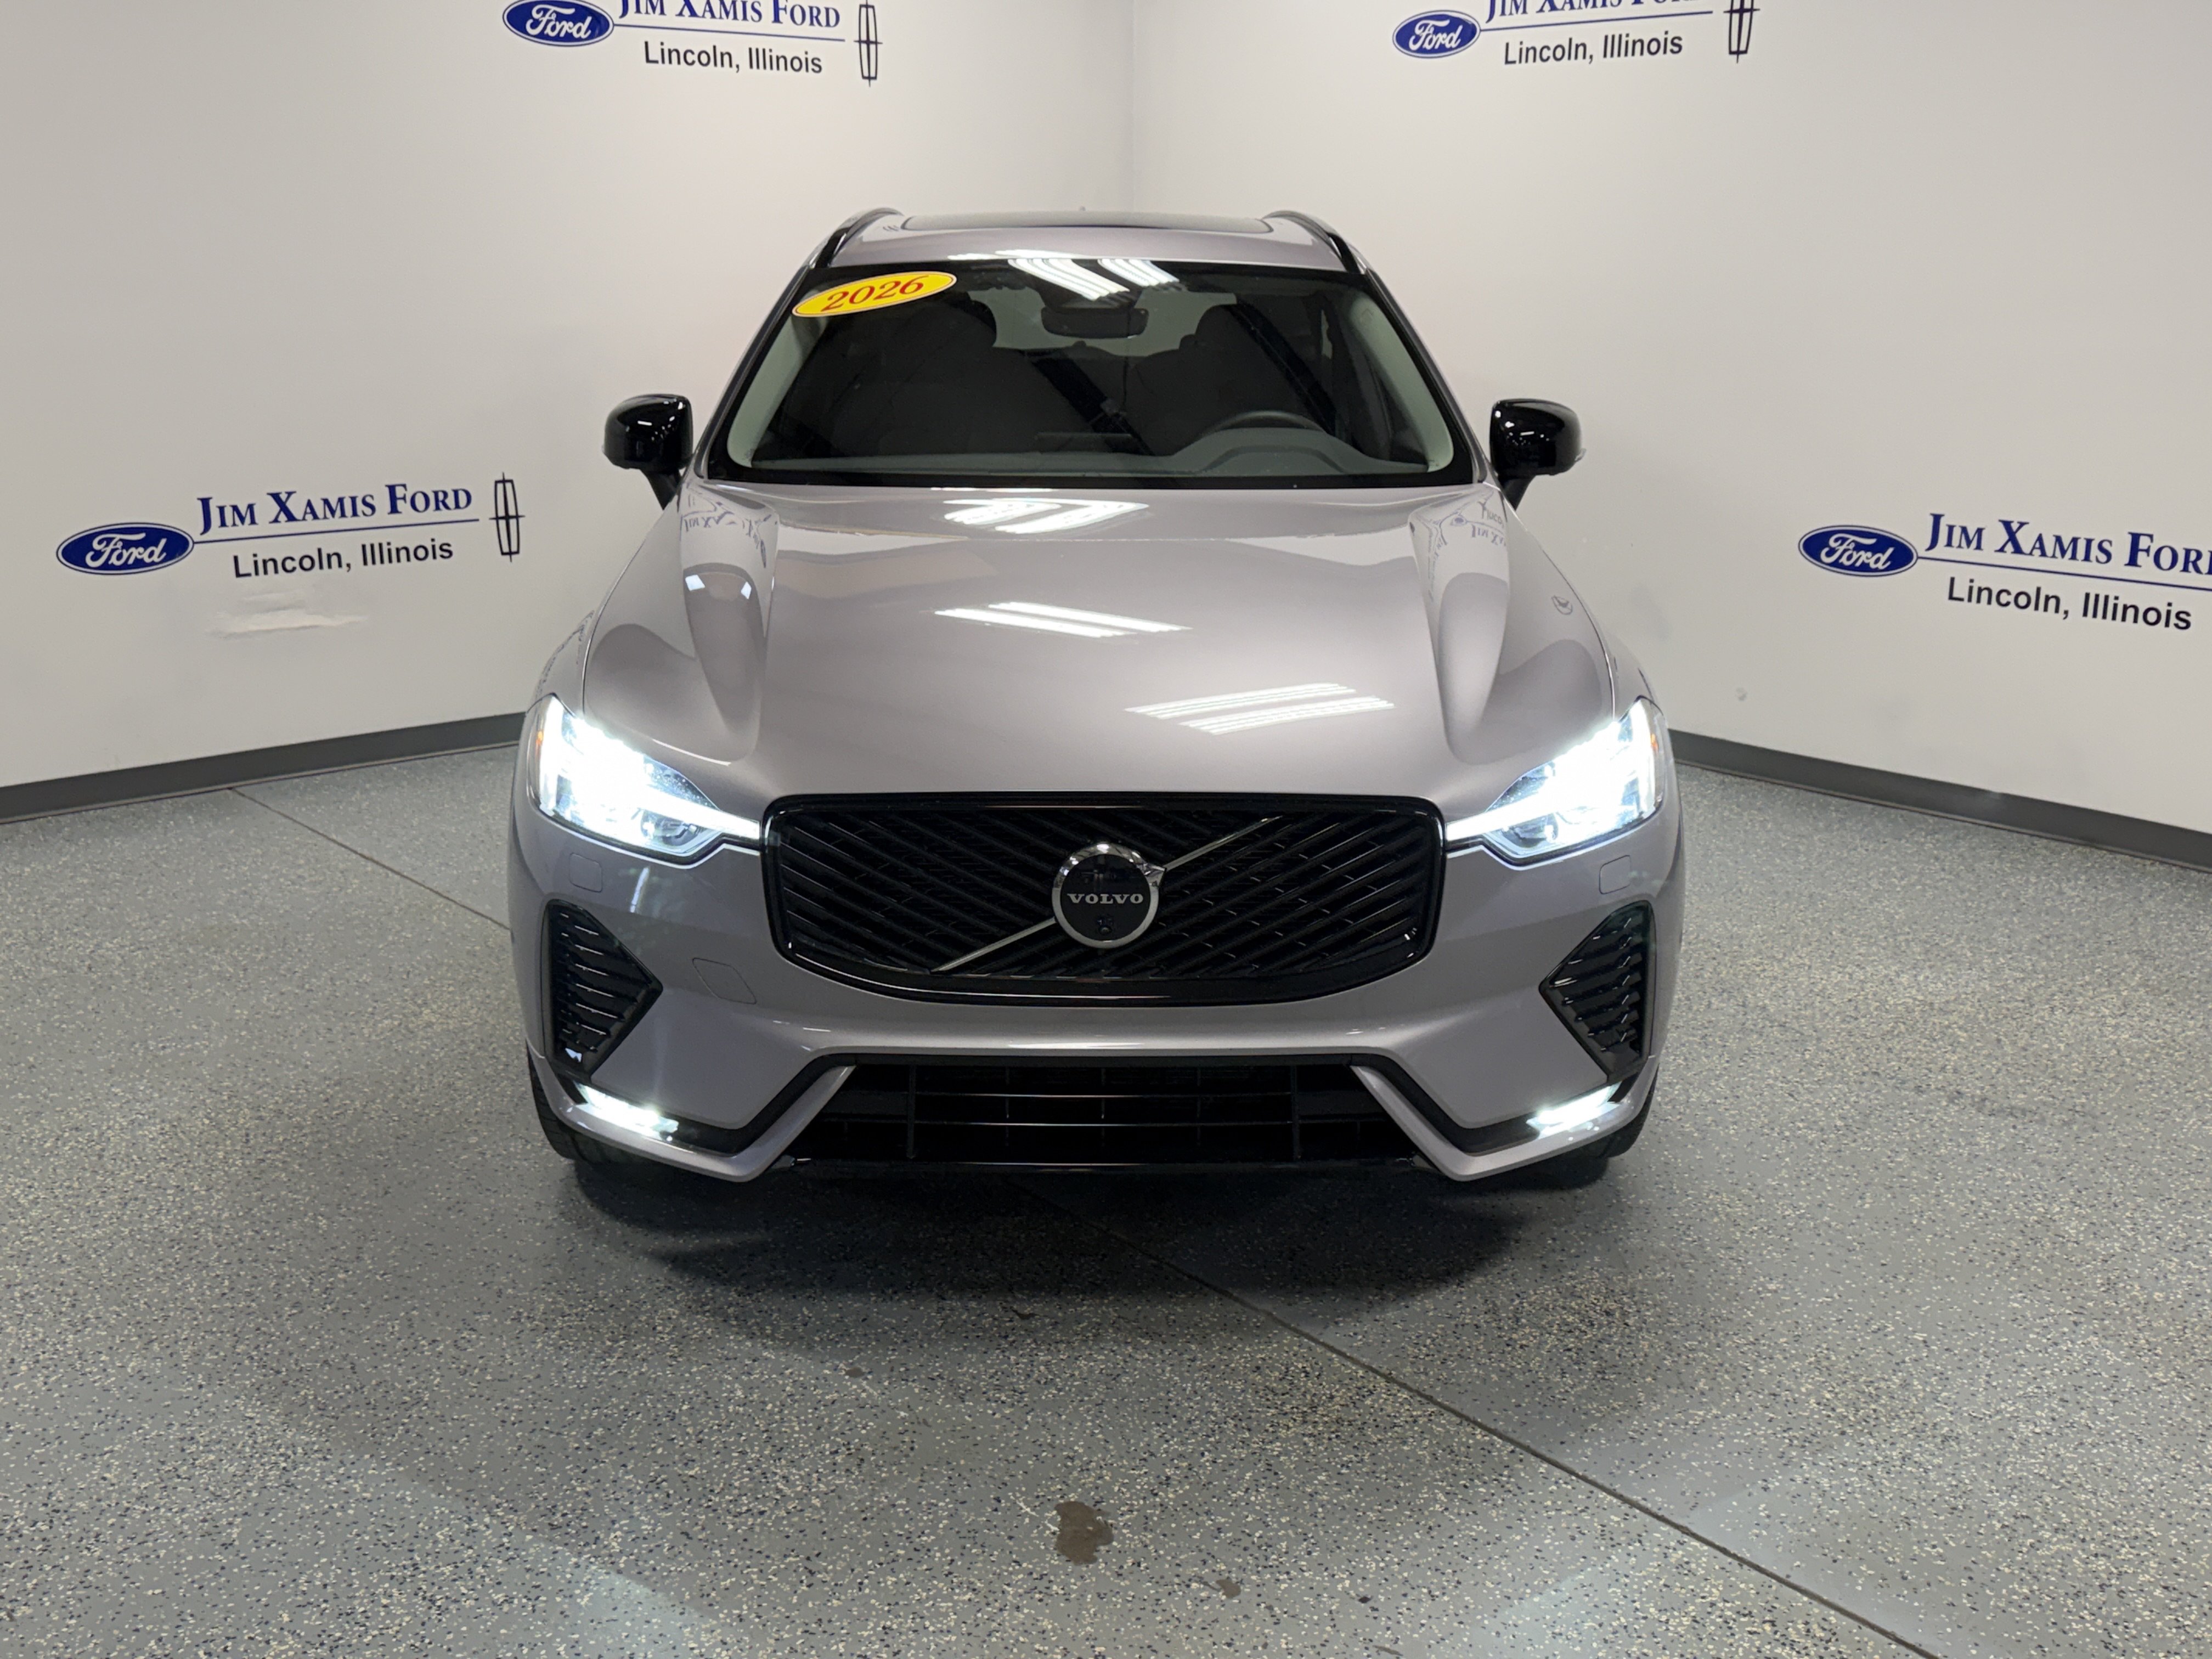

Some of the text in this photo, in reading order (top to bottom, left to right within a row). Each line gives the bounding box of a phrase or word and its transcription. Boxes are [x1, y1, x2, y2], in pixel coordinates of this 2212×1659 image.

[526, 4, 591, 39] Ford
[771, 0, 840, 28] FORD
[1408, 19, 1462, 51] Ford
[1504, 31, 1683, 65] Lincoln, Illinois
[644, 41, 822, 73] Lincoln, Illinois
[820, 275, 929, 312] 2026
[197, 483, 473, 537] JIM XAMIS FORD
[86, 533, 167, 567] Ford
[233, 538, 454, 579] Lincoln, Illinois
[1820, 533, 1892, 569] Ford
[1925, 512, 2212, 576] JIM XAMIS FOR
[1947, 576, 2192, 631] Lincoln, Illinois
[1066, 893, 1144, 904] VOLVO
